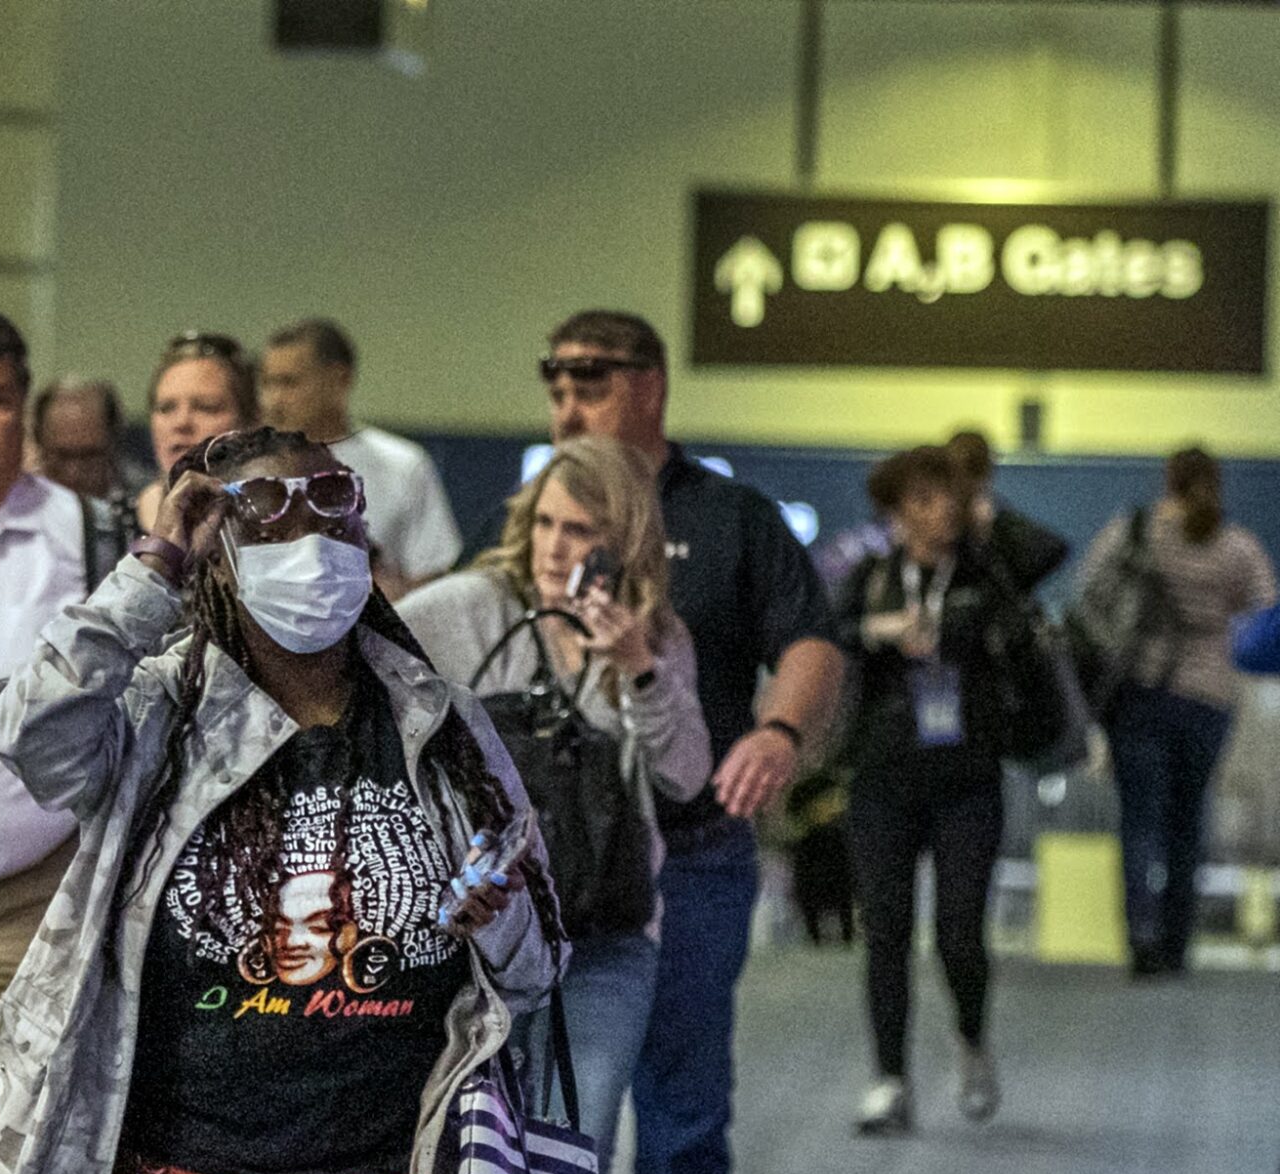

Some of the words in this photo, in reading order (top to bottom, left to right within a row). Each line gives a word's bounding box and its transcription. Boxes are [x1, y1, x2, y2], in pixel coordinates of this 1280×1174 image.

[1001, 223, 1204, 300] Gates
[373, 822, 408, 874] Soulful
[233, 987, 292, 1020] Am
[303, 989, 415, 1019] Woman
